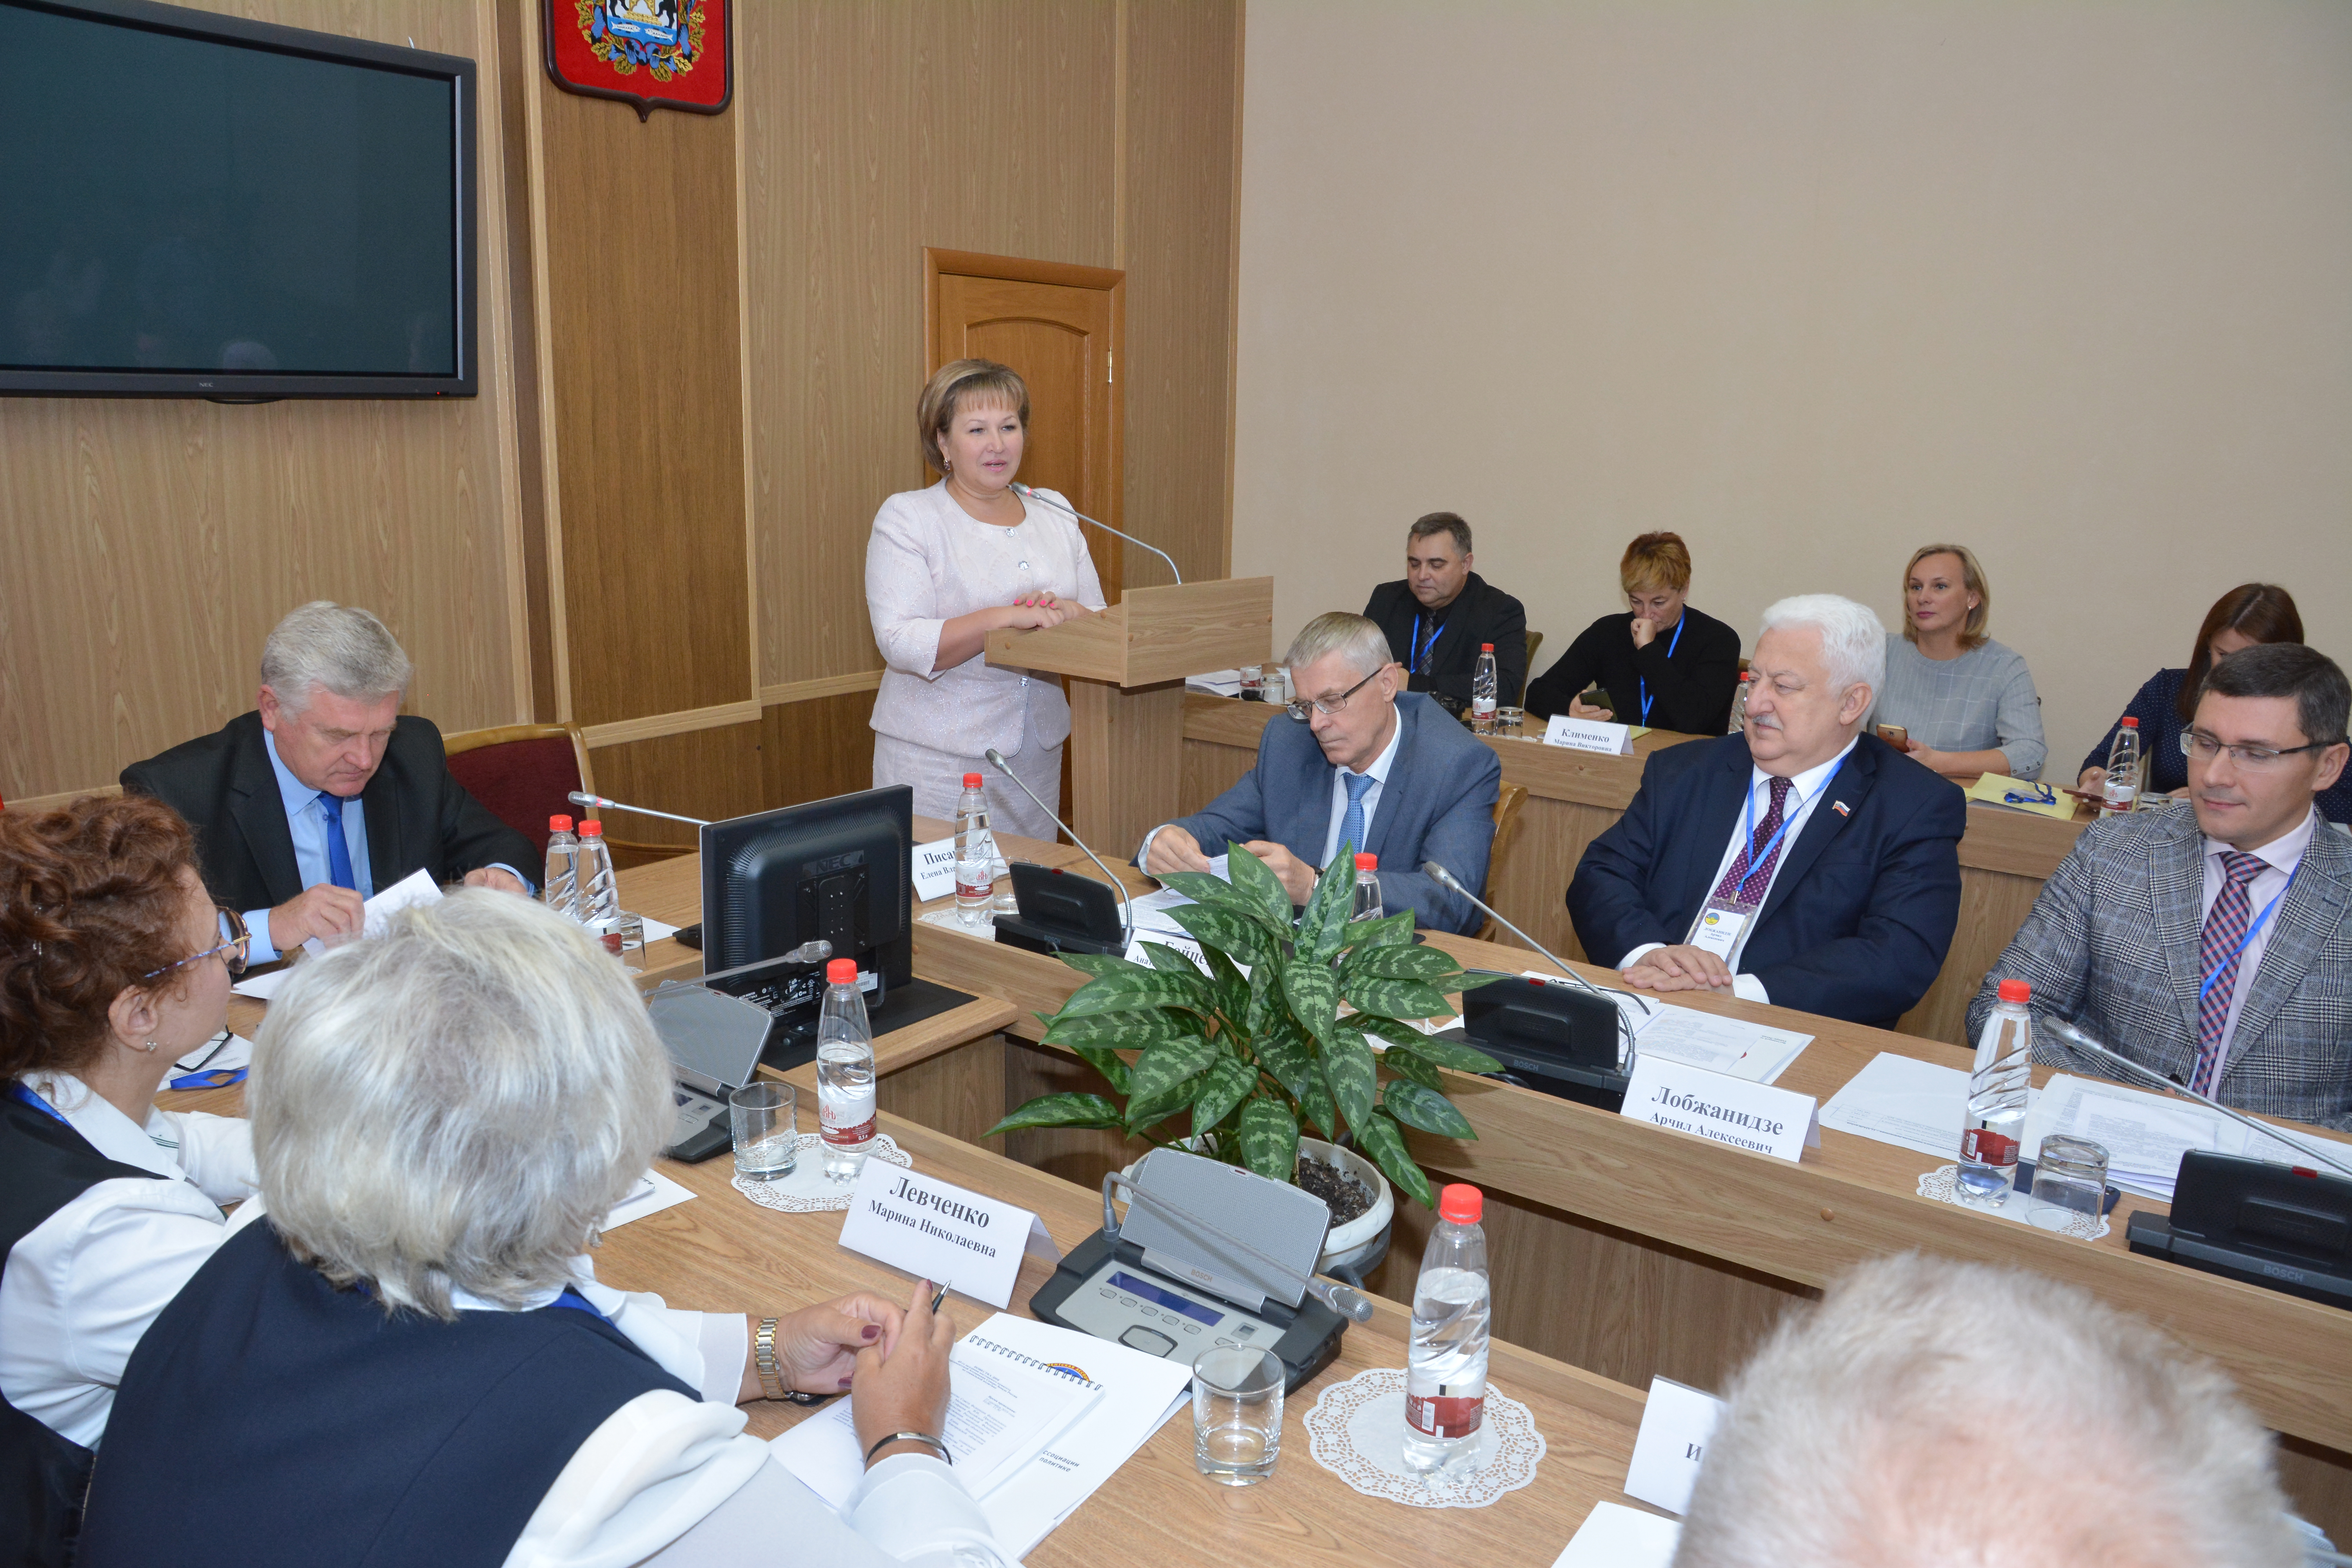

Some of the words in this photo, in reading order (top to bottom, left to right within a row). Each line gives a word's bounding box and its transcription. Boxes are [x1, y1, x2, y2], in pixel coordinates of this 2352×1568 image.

[1561, 728, 1610, 743] Клименко
[1554, 739, 1576, 747] Марина
[1577, 742, 1612, 752] Викторовна
[816, 853, 851, 874] NEC
[923, 850, 956, 865] Писа
[920, 871, 942, 880] Елена
[943, 865, 956, 874] Вла
[1514, 1060, 1539, 1071] BOSCH
[1651, 1086, 1783, 1135] Лобжанидзе
[1650, 1112, 1692, 1132] Арчил
[1695, 1125, 1773, 1154] Алексеевич
[889, 1176, 989, 1228] Левченко
[868, 1200, 916, 1228] Марина
[919, 1218, 996, 1258] Николаевна
[1191, 1269, 1212, 1283] BOSCH
[1043, 1450, 1080, 1467] ссоциации
[1684, 1442, 1704, 1462] И
[1039, 1457, 1071, 1472] политике
